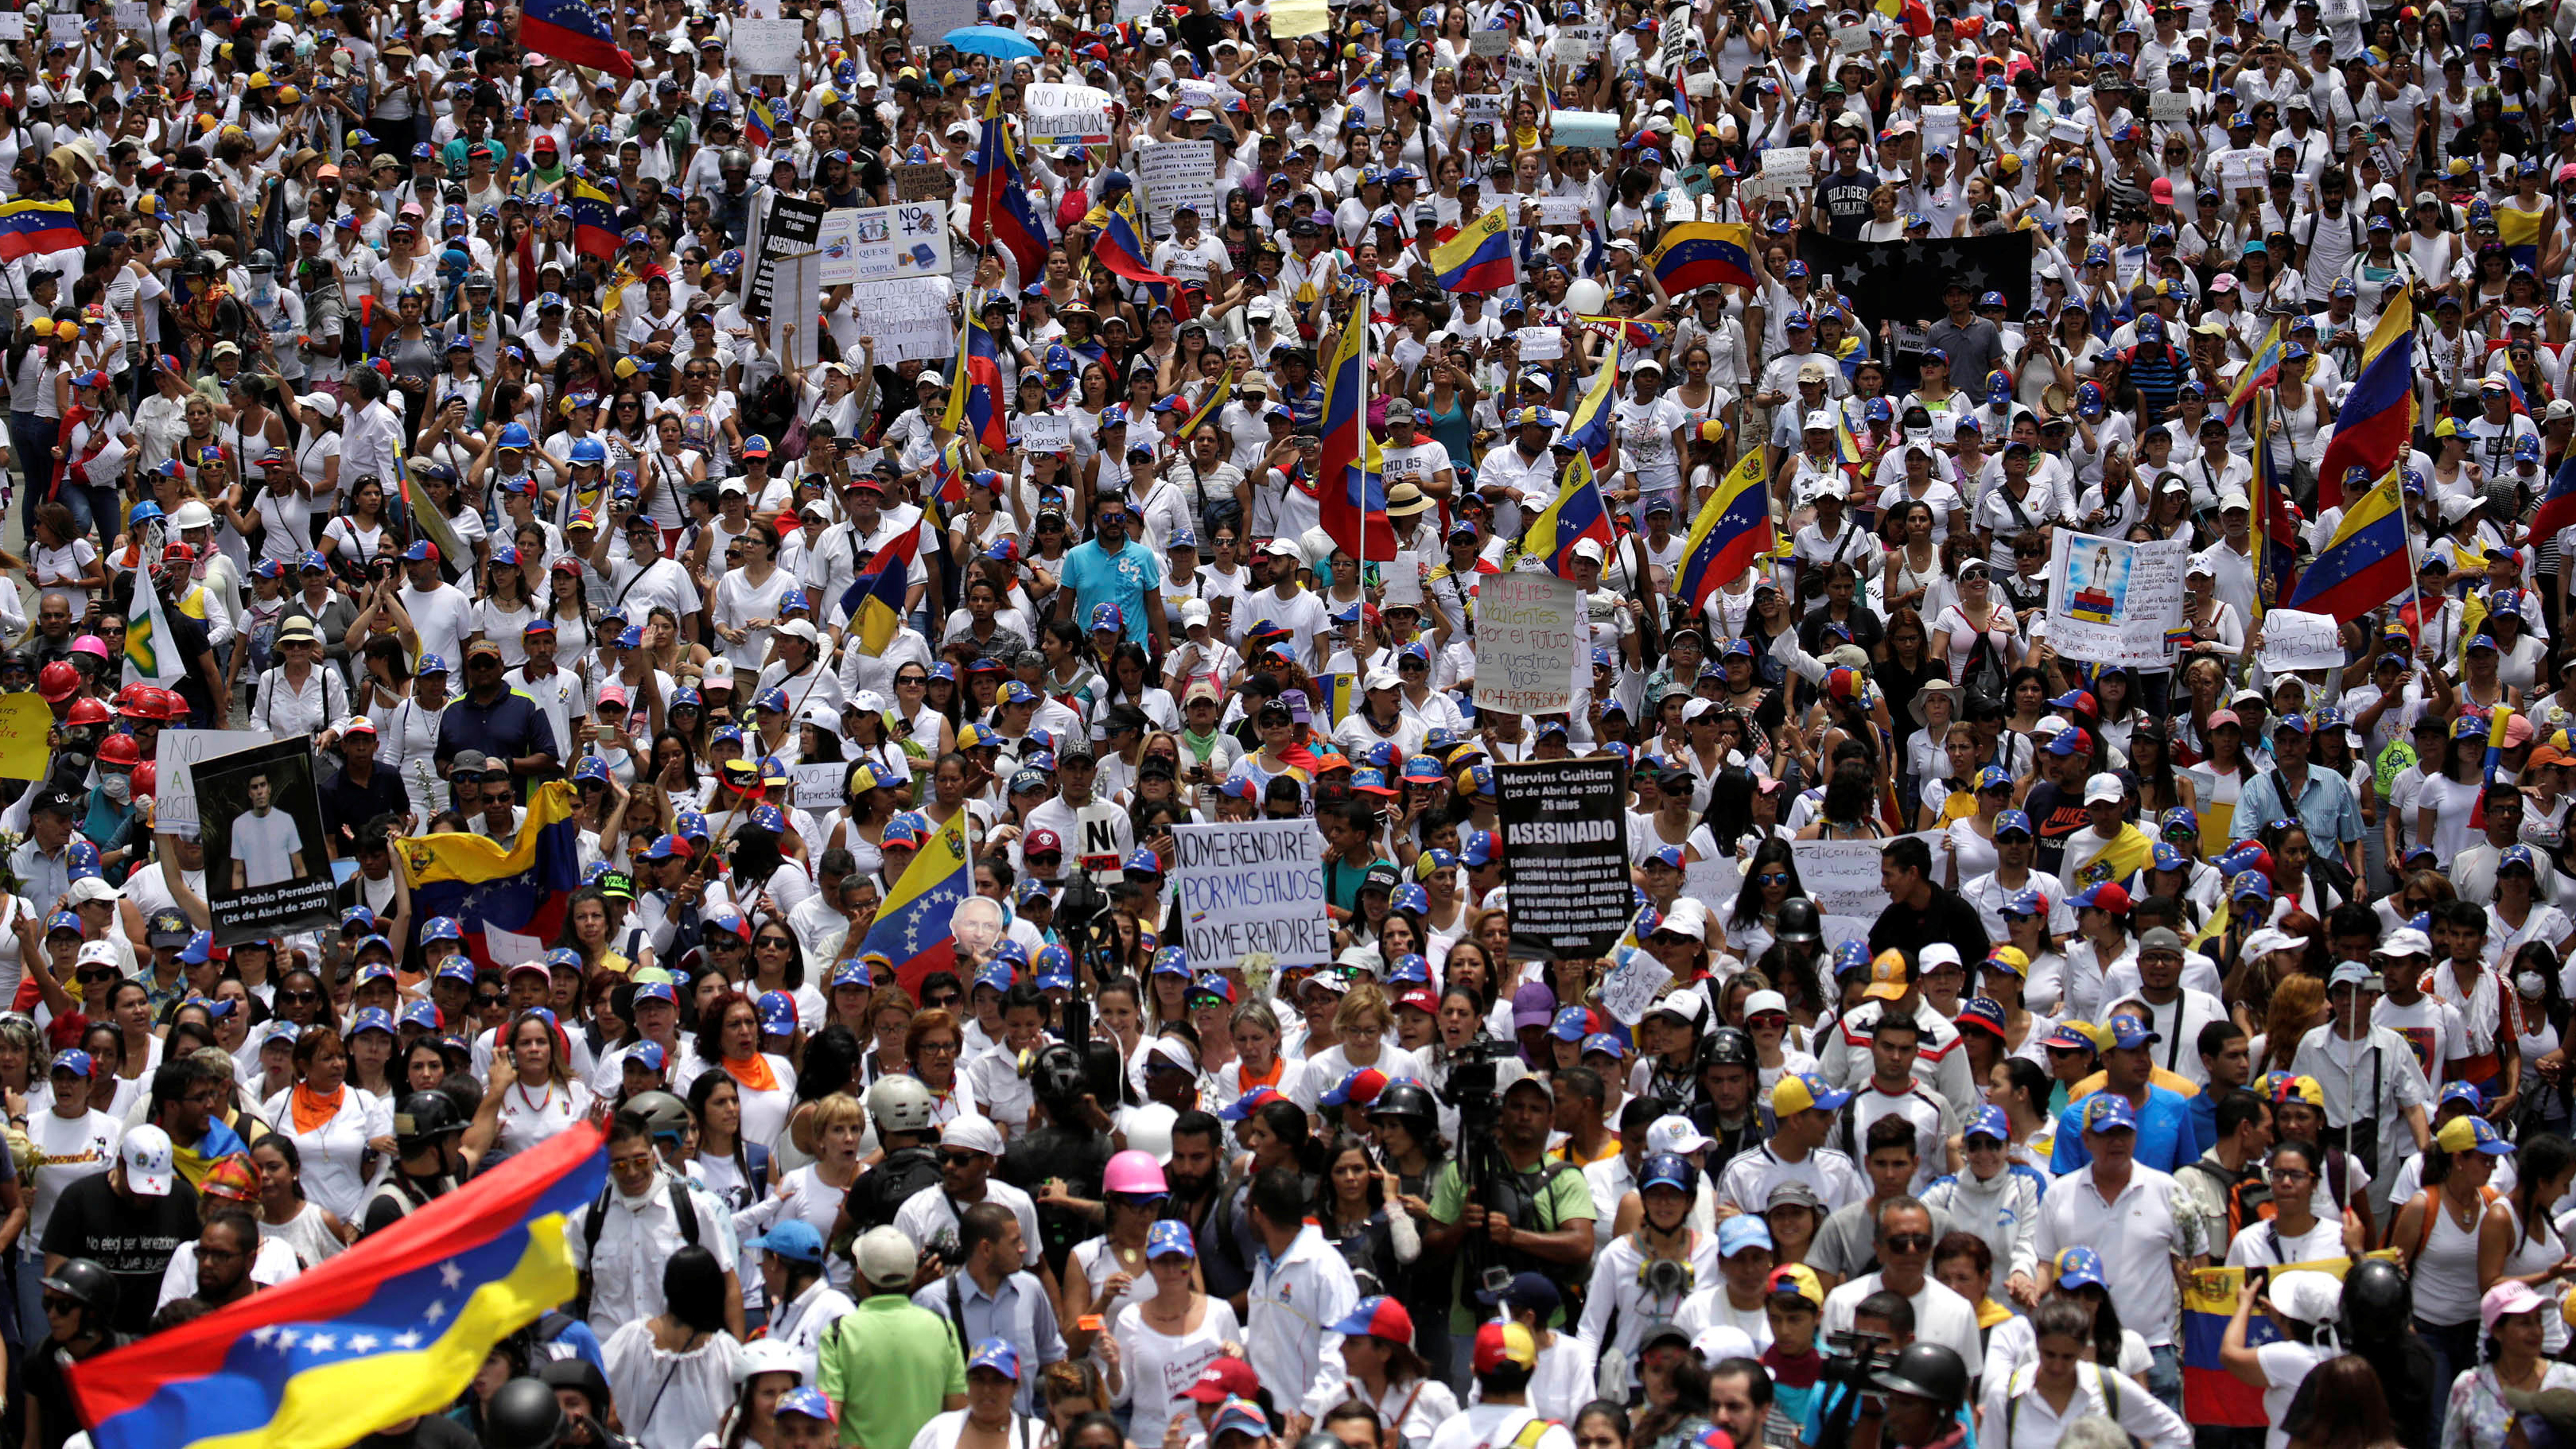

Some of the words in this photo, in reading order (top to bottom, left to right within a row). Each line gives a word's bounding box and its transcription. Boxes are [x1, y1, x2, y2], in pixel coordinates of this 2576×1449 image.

[1574, 30, 1588, 40] NO
[1509, 56, 1521, 68] NO
[1034, 90, 1054, 107] NO
[1466, 97, 1480, 109] NO
[2154, 96, 2169, 106] NO
[1029, 110, 1103, 134] REPRESIÓN
[903, 177, 942, 186] MADURO
[1742, 181, 1763, 199] NO
[1828, 186, 1868, 202] HILFIGER
[1482, 196, 1495, 205] NO
[1852, 202, 1866, 211] NYC
[779, 208, 796, 219] Carlos
[899, 207, 921, 221] NO
[791, 222, 805, 232] años
[766, 235, 814, 255] ASESINADO
[859, 248, 878, 258] QUE
[1174, 251, 1187, 260] NO
[861, 264, 896, 274] CUMPLA
[1406, 457, 1421, 469] 85
[1510, 628, 1524, 643] el
[1476, 647, 1492, 664] de
[1499, 652, 1560, 670] nuestros
[169, 734, 202, 763] NO
[171, 771, 185, 792] A
[797, 769, 820, 783] NO
[1502, 772, 1556, 786] Mervins
[1560, 770, 1613, 782] Guitian
[1506, 788, 1523, 799] (20
[1526, 787, 1539, 796] de
[1542, 786, 1568, 795] Abril
[1570, 785, 1583, 794] de
[1585, 784, 1613, 794] 2017)
[1542, 800, 1554, 810] 26
[1556, 798, 1579, 810] años
[2050, 806, 2091, 822] NIKE
[1508, 820, 1616, 845] ASESINADO
[2041, 837, 2060, 849] TRACK
[1510, 857, 1545, 868] Falleció
[1547, 860, 1561, 868] por
[1563, 856, 1603, 868] disparos
[1604, 856, 1622, 865] que
[1516, 871, 1547, 880] recibió
[1562, 871, 1570, 880] la
[1572, 869, 1601, 881] pierna
[1610, 868, 1618, 877] el
[1262, 868, 1323, 903] HIJOS
[1509, 884, 1549, 894] abdomen
[1552, 884, 1586, 894] durante
[1590, 881, 1628, 892] protesta
[211, 899, 239, 912] Juan
[240, 892, 276, 907] Pablo
[278, 880, 334, 899] Pernalete
[1527, 897, 1536, 906] la
[1537, 895, 1571, 907] entrada
[1572, 895, 1587, 906] del
[1589, 894, 1617, 905] Barrio
[1619, 894, 1625, 903] 5
[223, 914, 240, 926] (26
[242, 911, 256, 921] de
[257, 905, 283, 919] Abril
[285, 903, 298, 913] de
[300, 897, 328, 911] 2017)
[1518, 910, 1529, 919] de
[1512, 922, 1571, 934] discapacidad
[1572, 920, 1625, 933] psicosocial
[1552, 936, 1591, 947] auditiva.
[87, 1236, 99, 1249] No
[123, 1237, 137, 1249] ser
